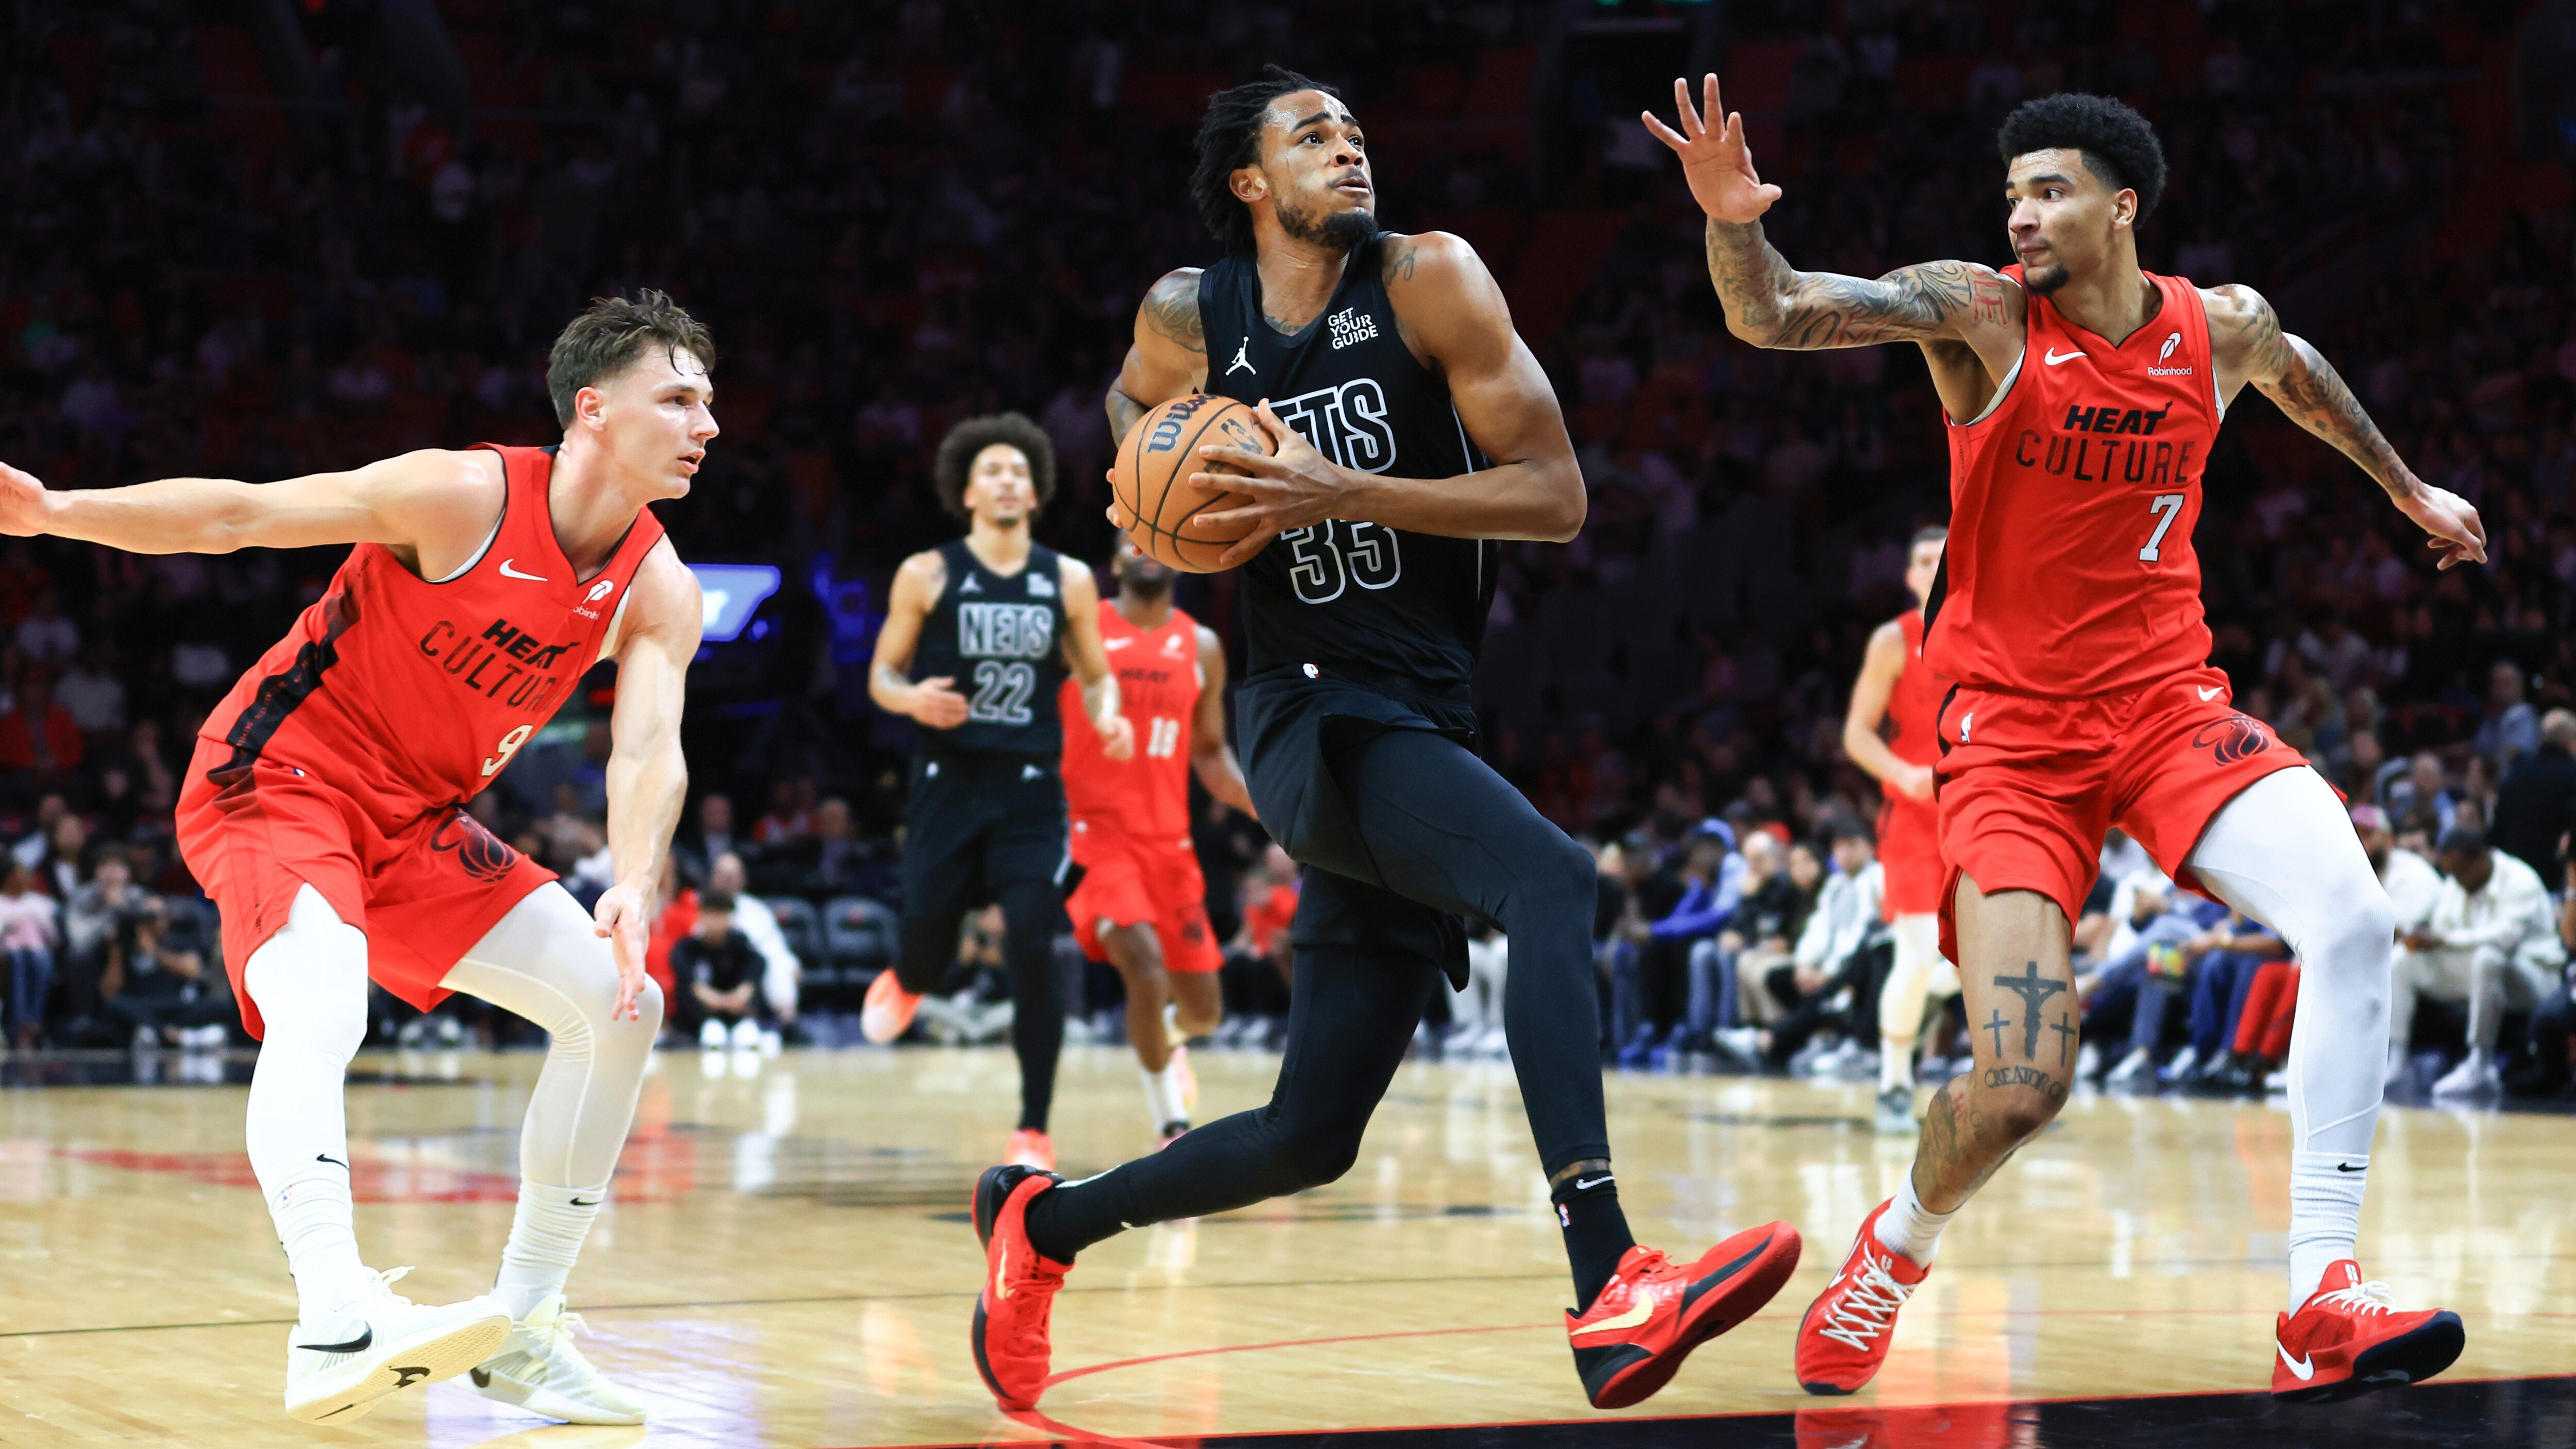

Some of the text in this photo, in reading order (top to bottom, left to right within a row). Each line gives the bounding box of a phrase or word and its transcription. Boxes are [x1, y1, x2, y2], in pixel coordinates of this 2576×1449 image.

[1328, 307, 1354, 327] GET
[1330, 314, 1373, 338] YOUR
[1332, 325, 1379, 349] GUIDE
[2147, 366, 2192, 376] Robinhood
[1252, 378, 1397, 473] TS
[2063, 400, 2173, 435] HEAT
[2015, 429, 2195, 484] CULTURE
[2139, 495, 2184, 562] 7
[481, 618, 581, 669] HEAT
[958, 602, 1054, 658] NETS
[969, 661, 1035, 725] 22
[481, 724, 534, 777] 9
